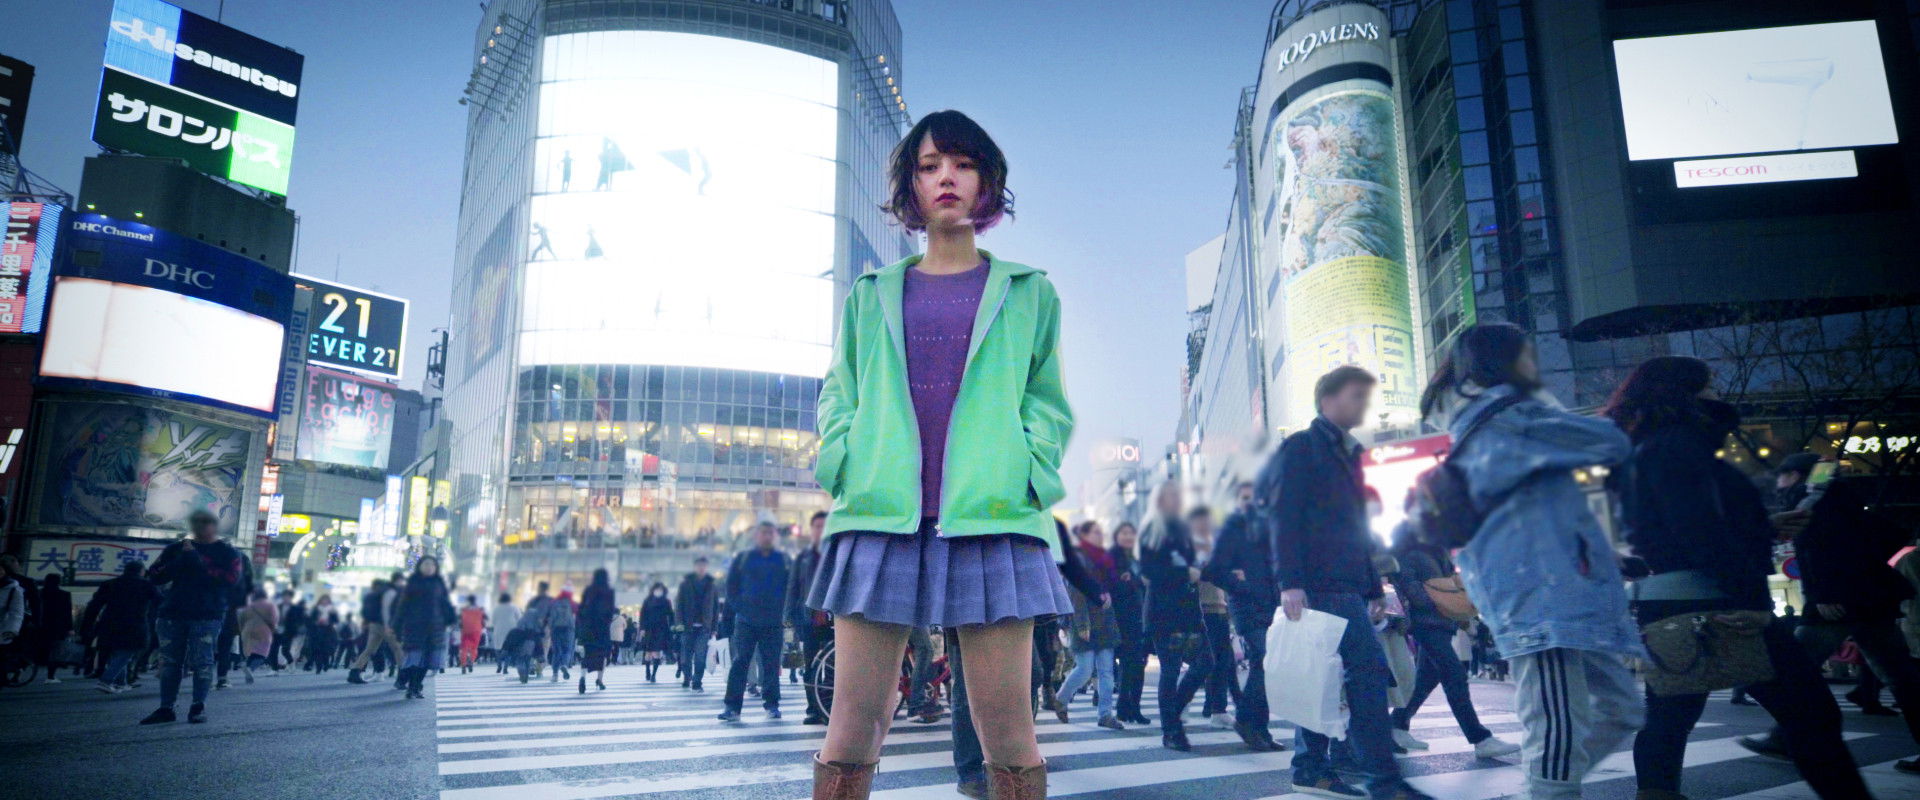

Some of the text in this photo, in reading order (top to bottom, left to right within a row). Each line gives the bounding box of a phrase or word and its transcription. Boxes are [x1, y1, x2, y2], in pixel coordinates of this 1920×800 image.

[107, 92, 281, 169] サロンパス
[1686, 163, 1768, 179] TESCOM
[73, 221, 154, 242] DHC Channel
[143, 257, 216, 289] DHC
[319, 293, 371, 338] 21
[308, 334, 396, 368] EVER 21
[281, 367, 298, 415] neon
